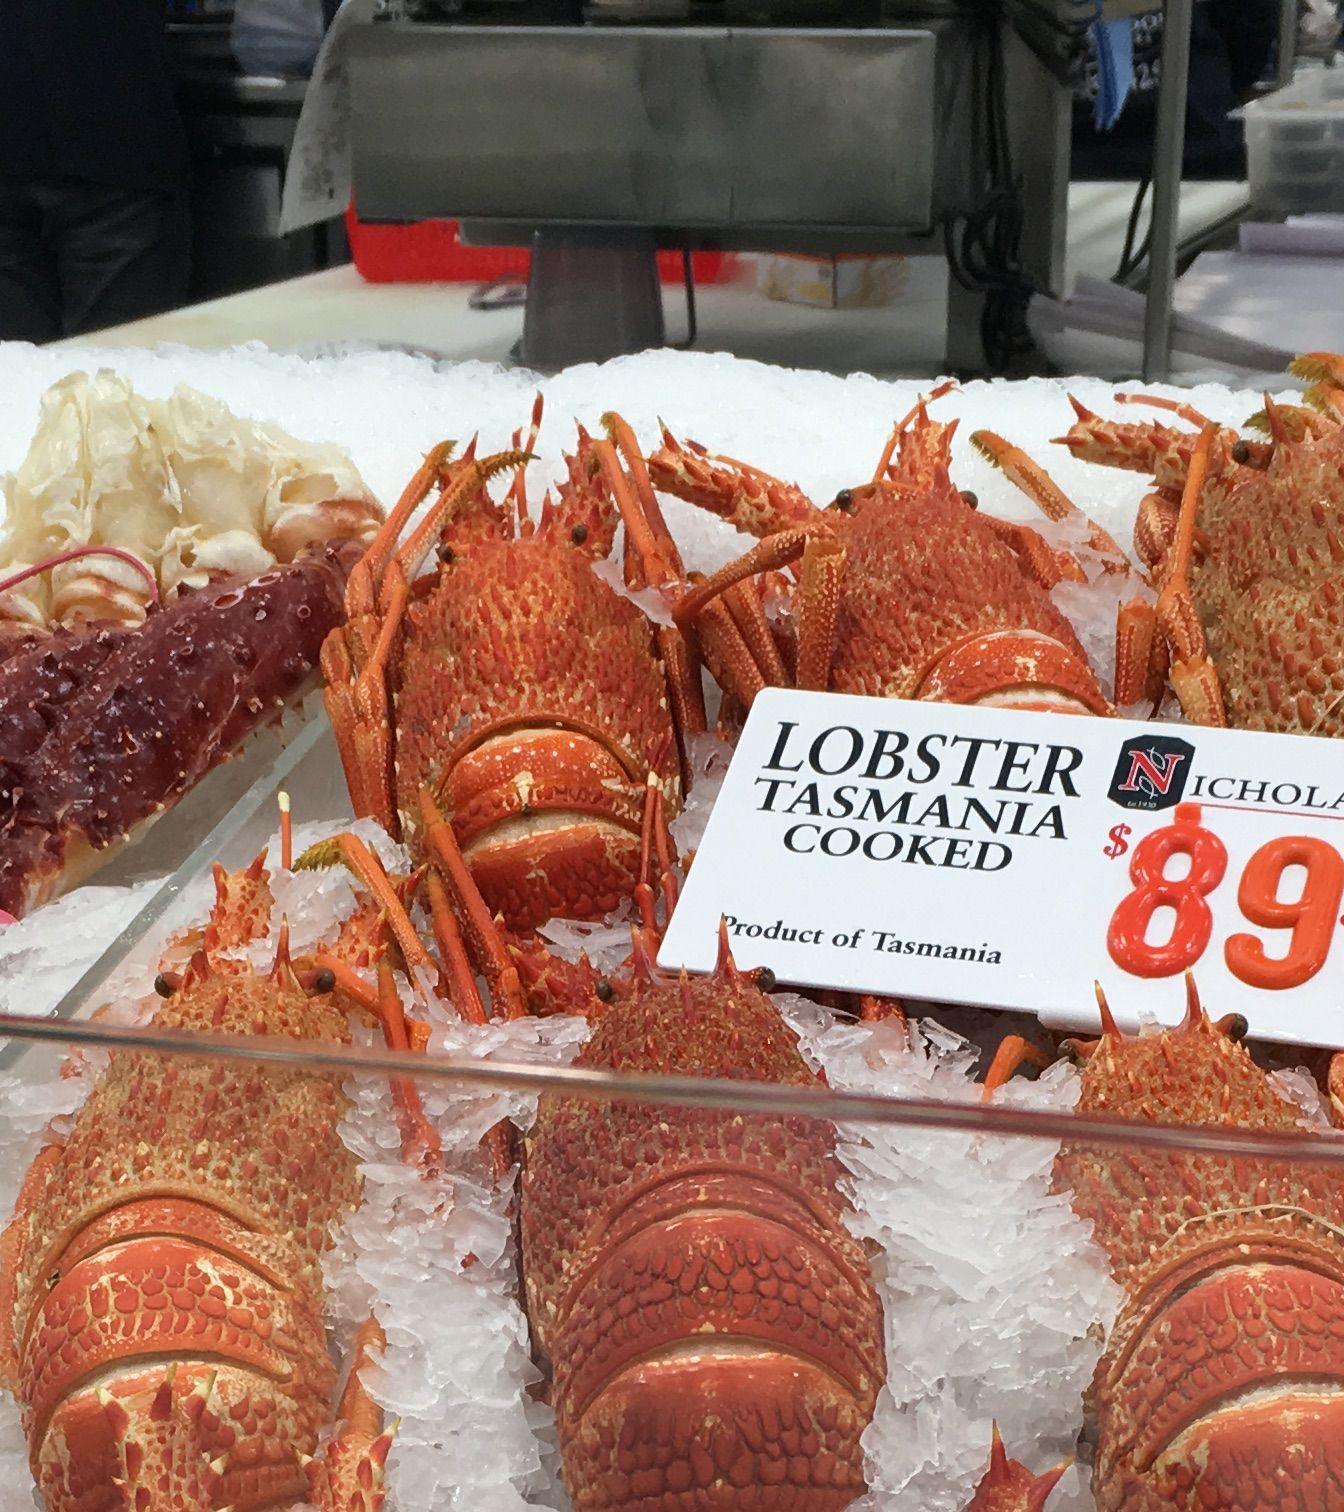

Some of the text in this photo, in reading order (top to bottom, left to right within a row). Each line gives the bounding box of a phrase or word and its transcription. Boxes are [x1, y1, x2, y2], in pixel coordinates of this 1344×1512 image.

[761, 721, 1084, 798] LOBSTER
[754, 777, 1069, 840] TASMANIA
[783, 823, 1013, 872] COOKED
[832, 929, 865, 951] of
[871, 930, 1003, 965] Tasmania
